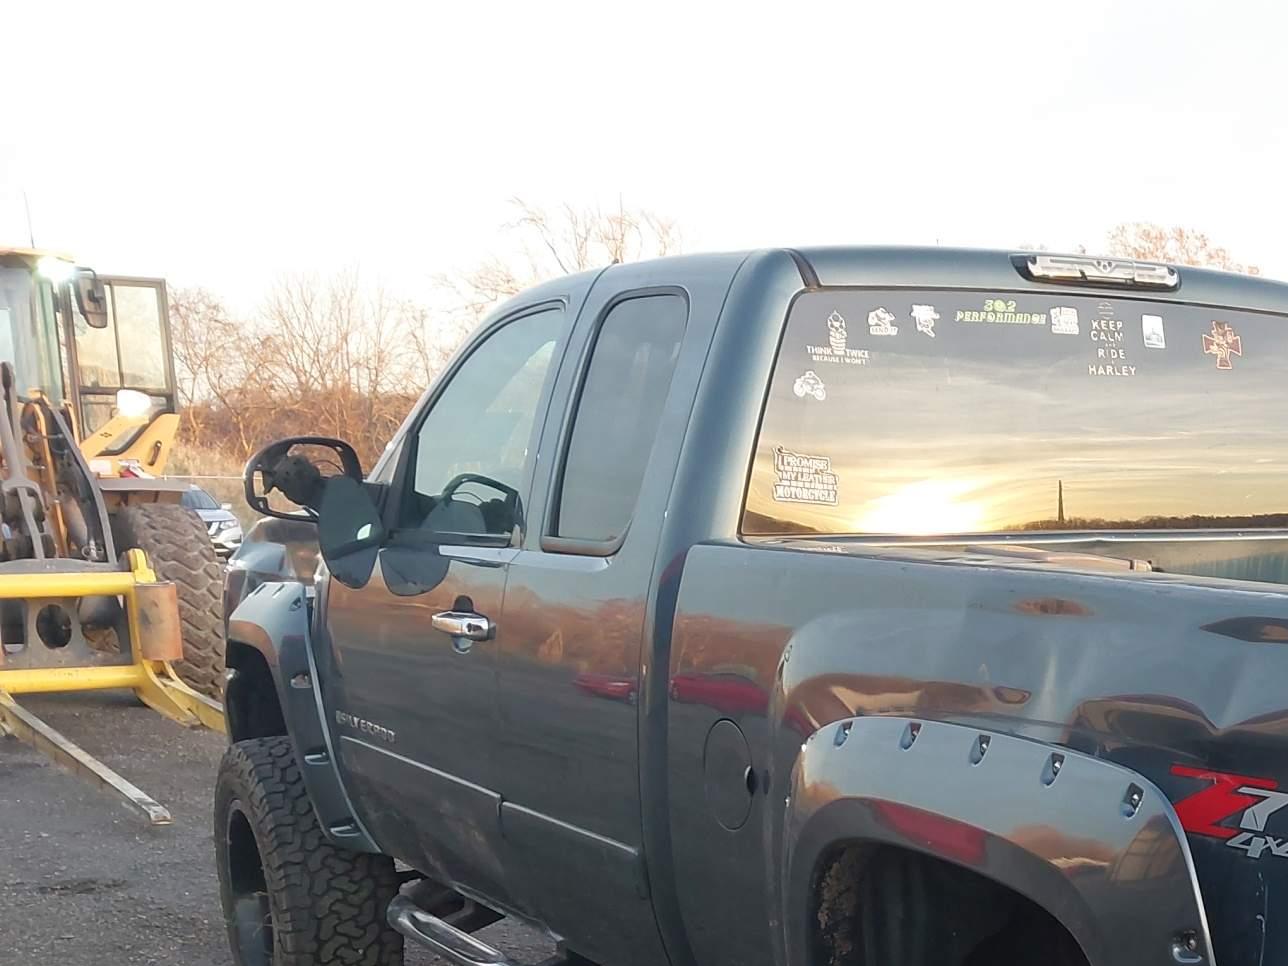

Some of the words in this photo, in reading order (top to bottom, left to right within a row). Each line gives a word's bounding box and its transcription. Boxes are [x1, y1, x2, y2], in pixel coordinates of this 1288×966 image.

[1091, 319, 1123, 331] KEEP
[1090, 331, 1124, 342] CALM
[806, 345, 833, 356] THINK
[845, 348, 870, 359] TWICE
[1097, 348, 1126, 359] RIDE
[812, 354, 840, 363] BECAUSE
[1088, 364, 1137, 376] HARLEY
[783, 455, 828, 470] PROMISE
[775, 485, 836, 502] MOTORCYCLE
